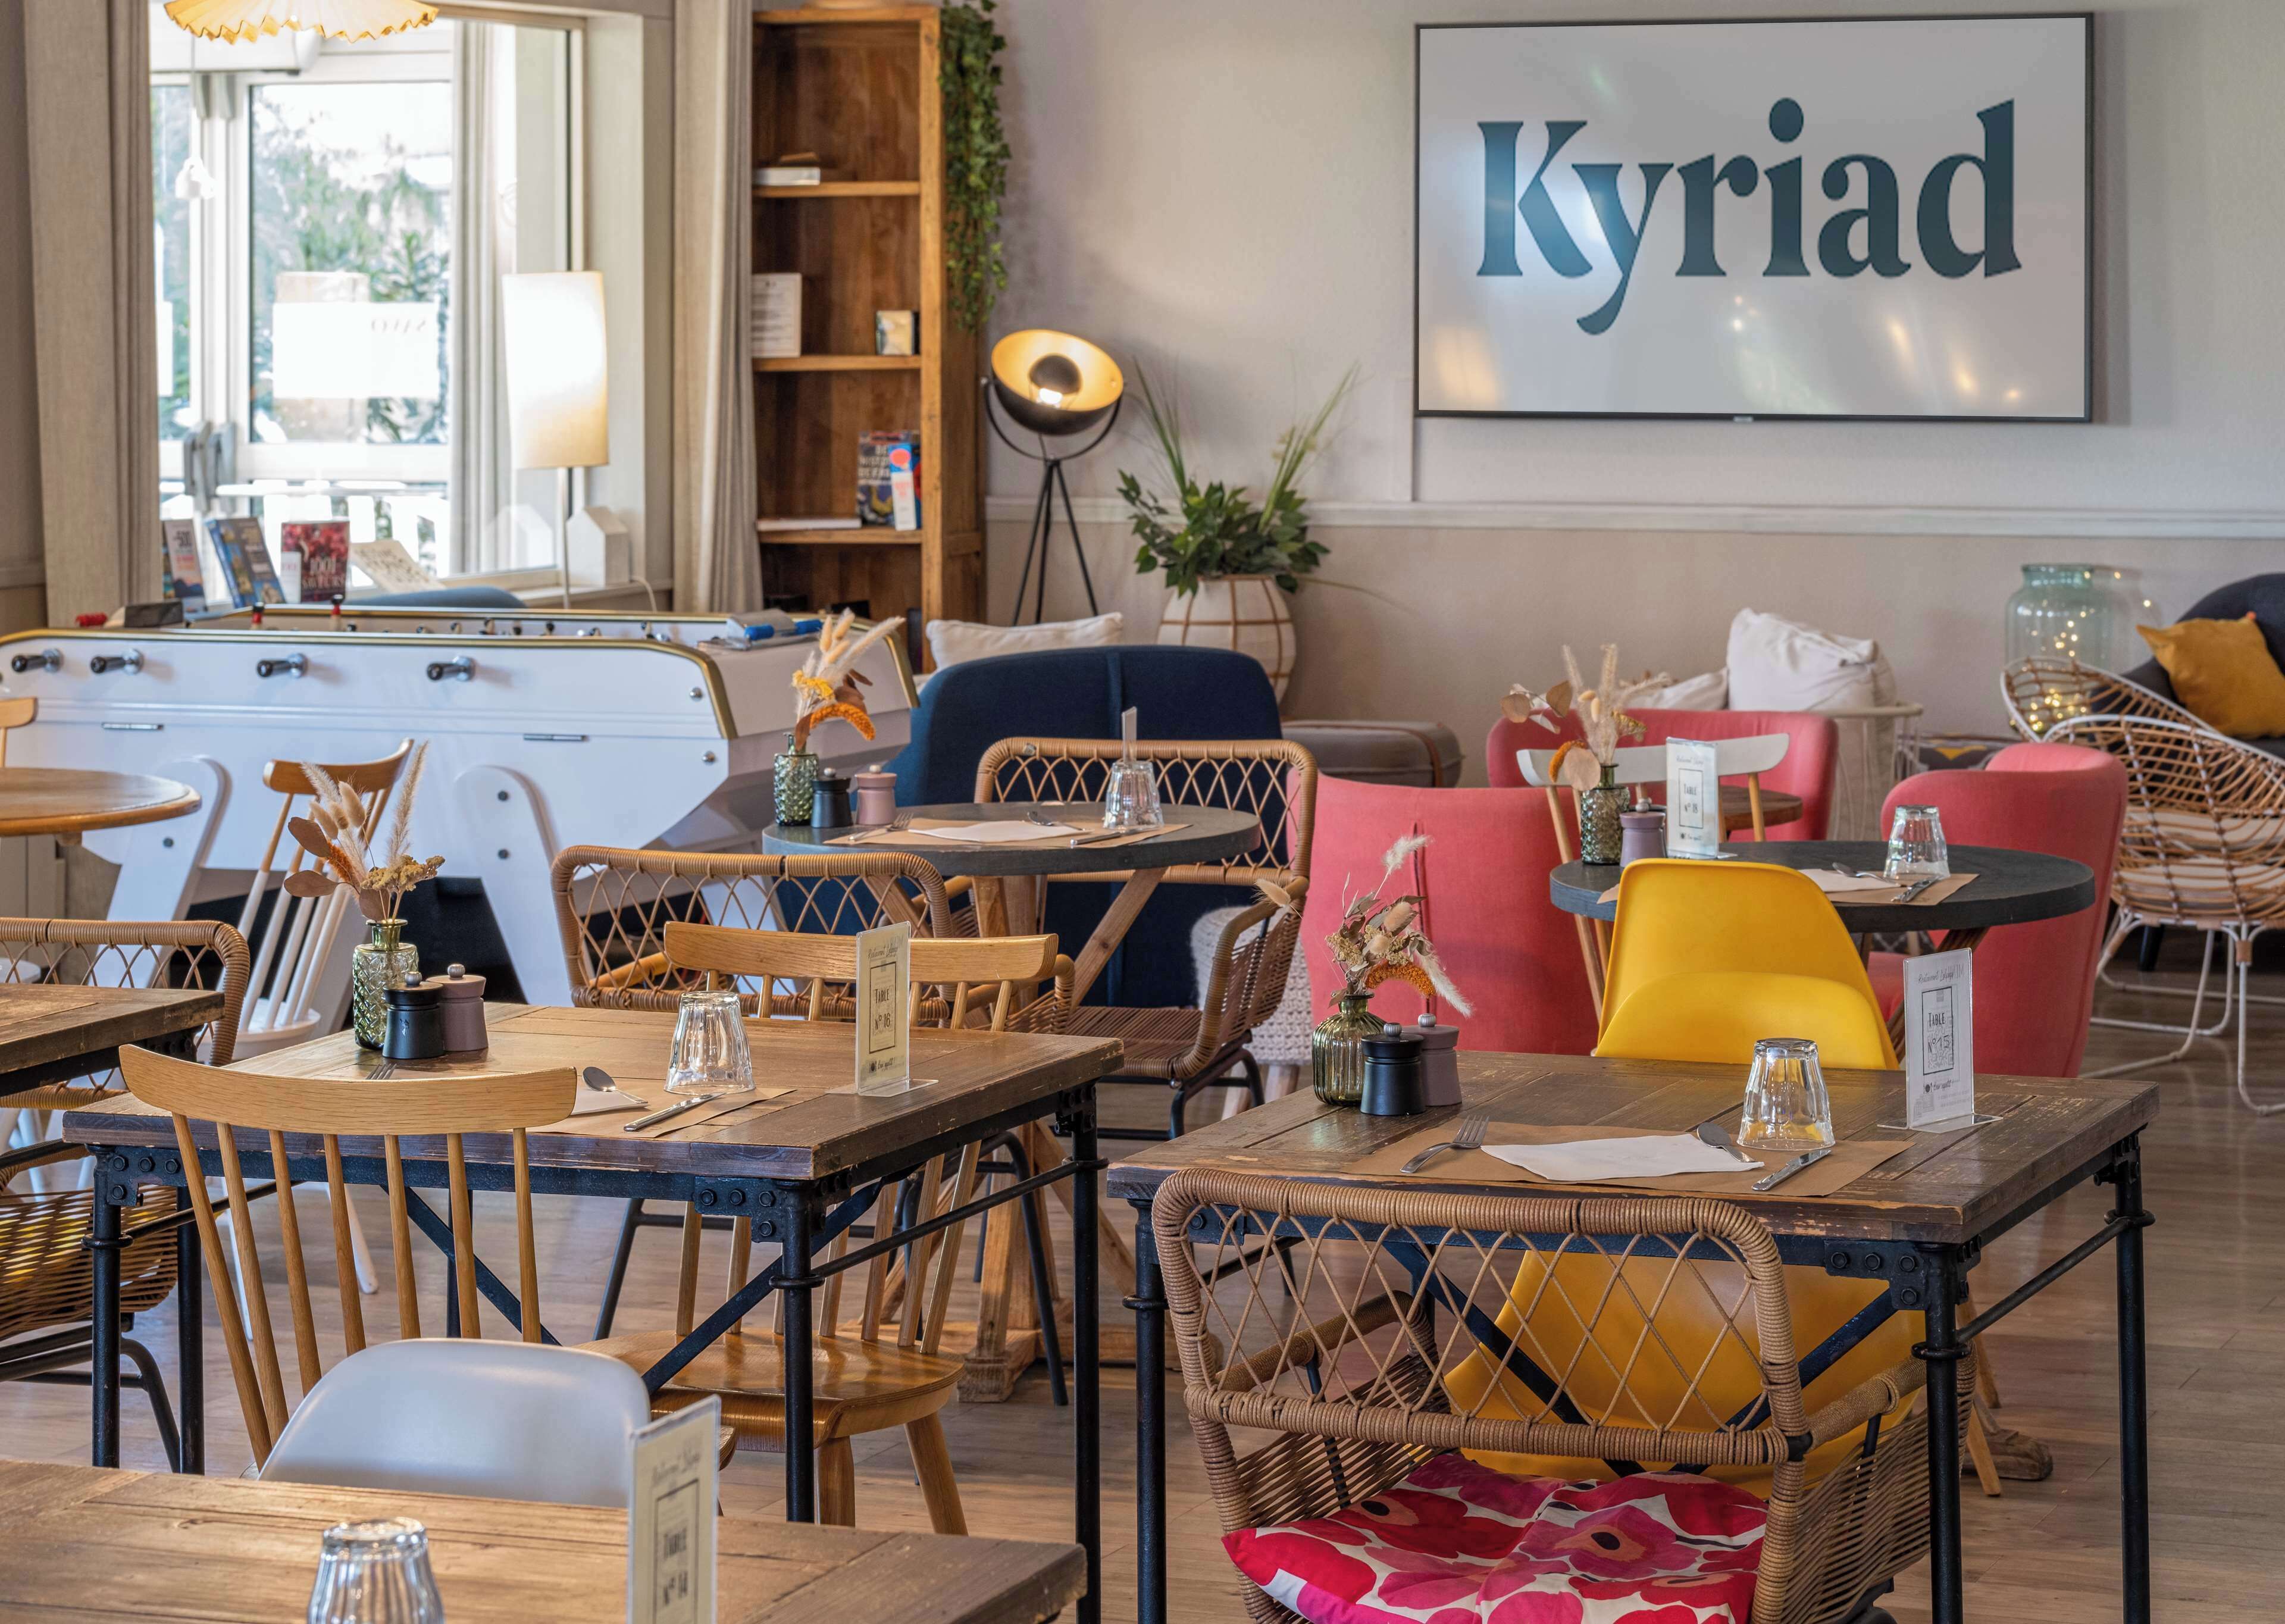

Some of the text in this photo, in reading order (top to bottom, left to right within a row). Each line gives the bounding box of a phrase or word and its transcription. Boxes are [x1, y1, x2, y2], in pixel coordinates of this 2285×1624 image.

[1476, 98, 2023, 335] Kyriad
[1683, 783, 1697, 796] TABLE
[875, 989, 890, 1004] TABLE
[884, 1013, 891, 1029] 16
[1928, 1012, 1945, 1028] TABLE
